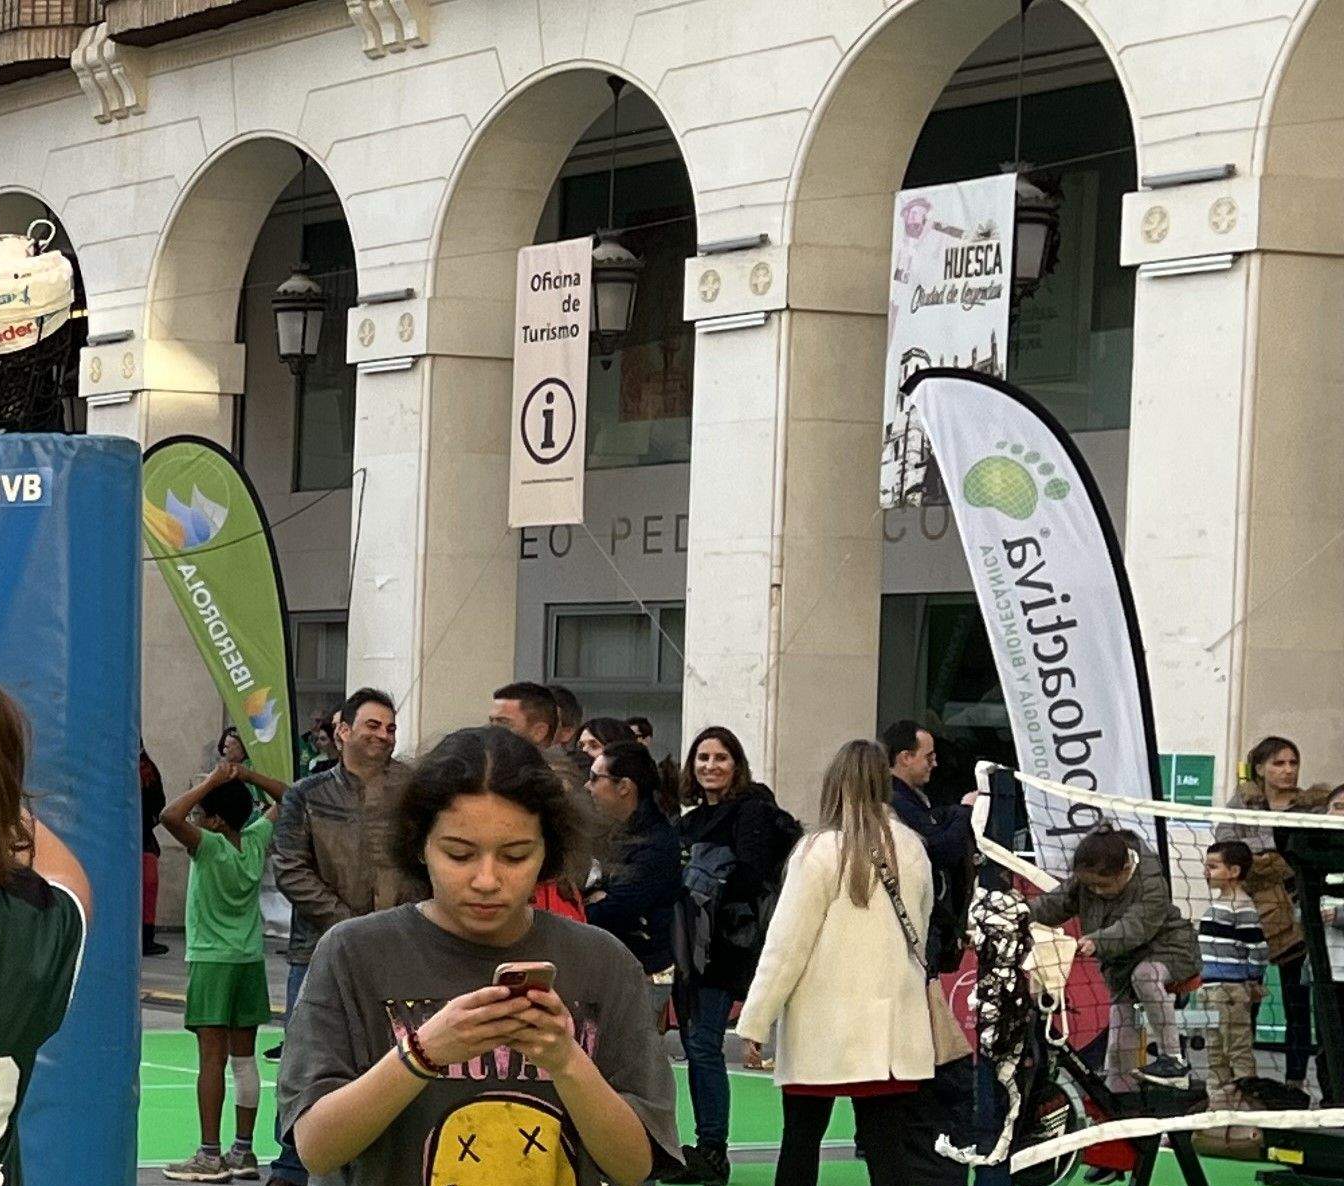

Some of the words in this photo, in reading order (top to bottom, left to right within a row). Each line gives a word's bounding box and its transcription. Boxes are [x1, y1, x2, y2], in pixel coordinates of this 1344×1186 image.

[943, 242, 1004, 280] HUESCA
[530, 272, 581, 292] Oficina
[562, 294, 581, 313] de
[522, 322, 580, 344] Turismo
